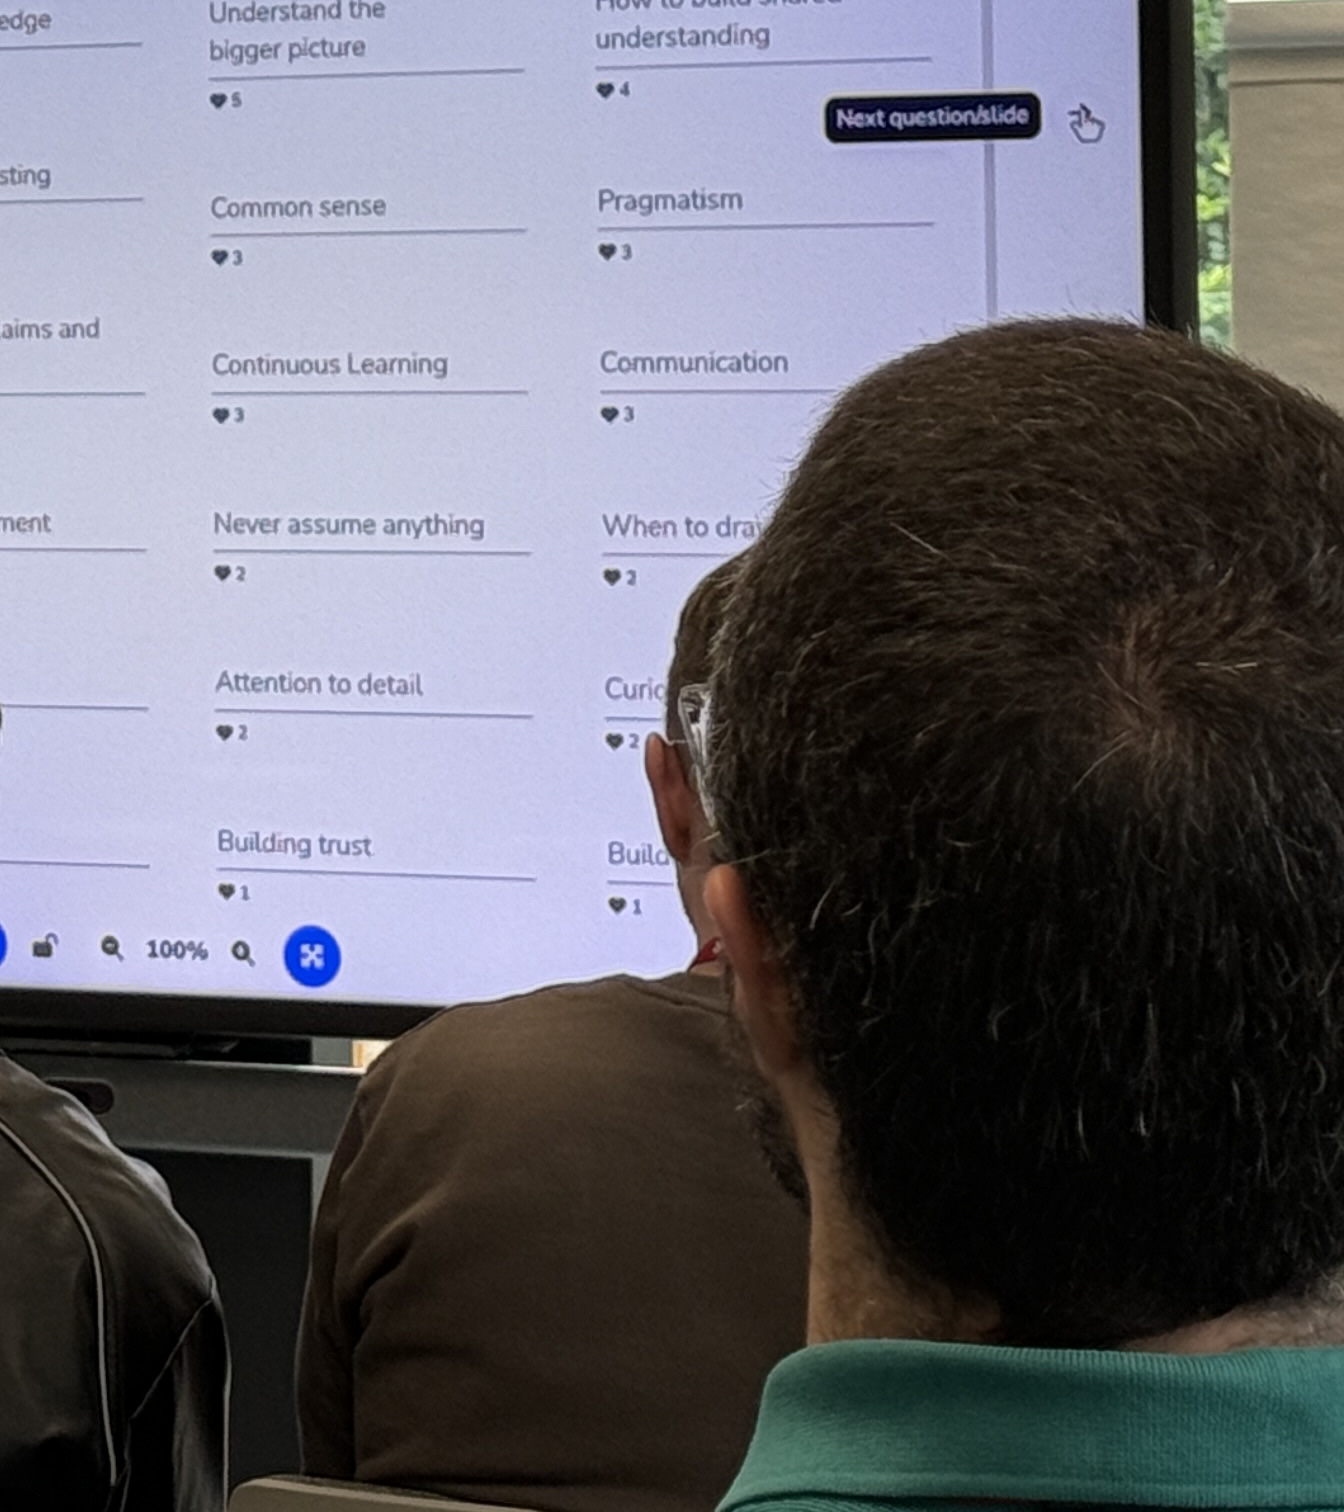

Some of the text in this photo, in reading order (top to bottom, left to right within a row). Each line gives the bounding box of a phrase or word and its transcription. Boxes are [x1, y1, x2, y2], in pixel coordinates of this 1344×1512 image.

[595, 22, 771, 51] understanding
[209, 36, 367, 67] bigger picture
[836, 104, 1030, 131] Next question/slide
[210, 195, 387, 220] Common sense
[598, 188, 744, 217] Pragmatism
[58, 316, 100, 340] and
[212, 352, 449, 380] Continuous Learning
[600, 349, 789, 375] Communication
[213, 511, 485, 541] Never assume anything
[601, 513, 678, 539] When
[684, 516, 710, 539] to
[215, 669, 424, 697] Attention to detail
[217, 828, 372, 860] Building trust
[146, 939, 209, 961] 100%
